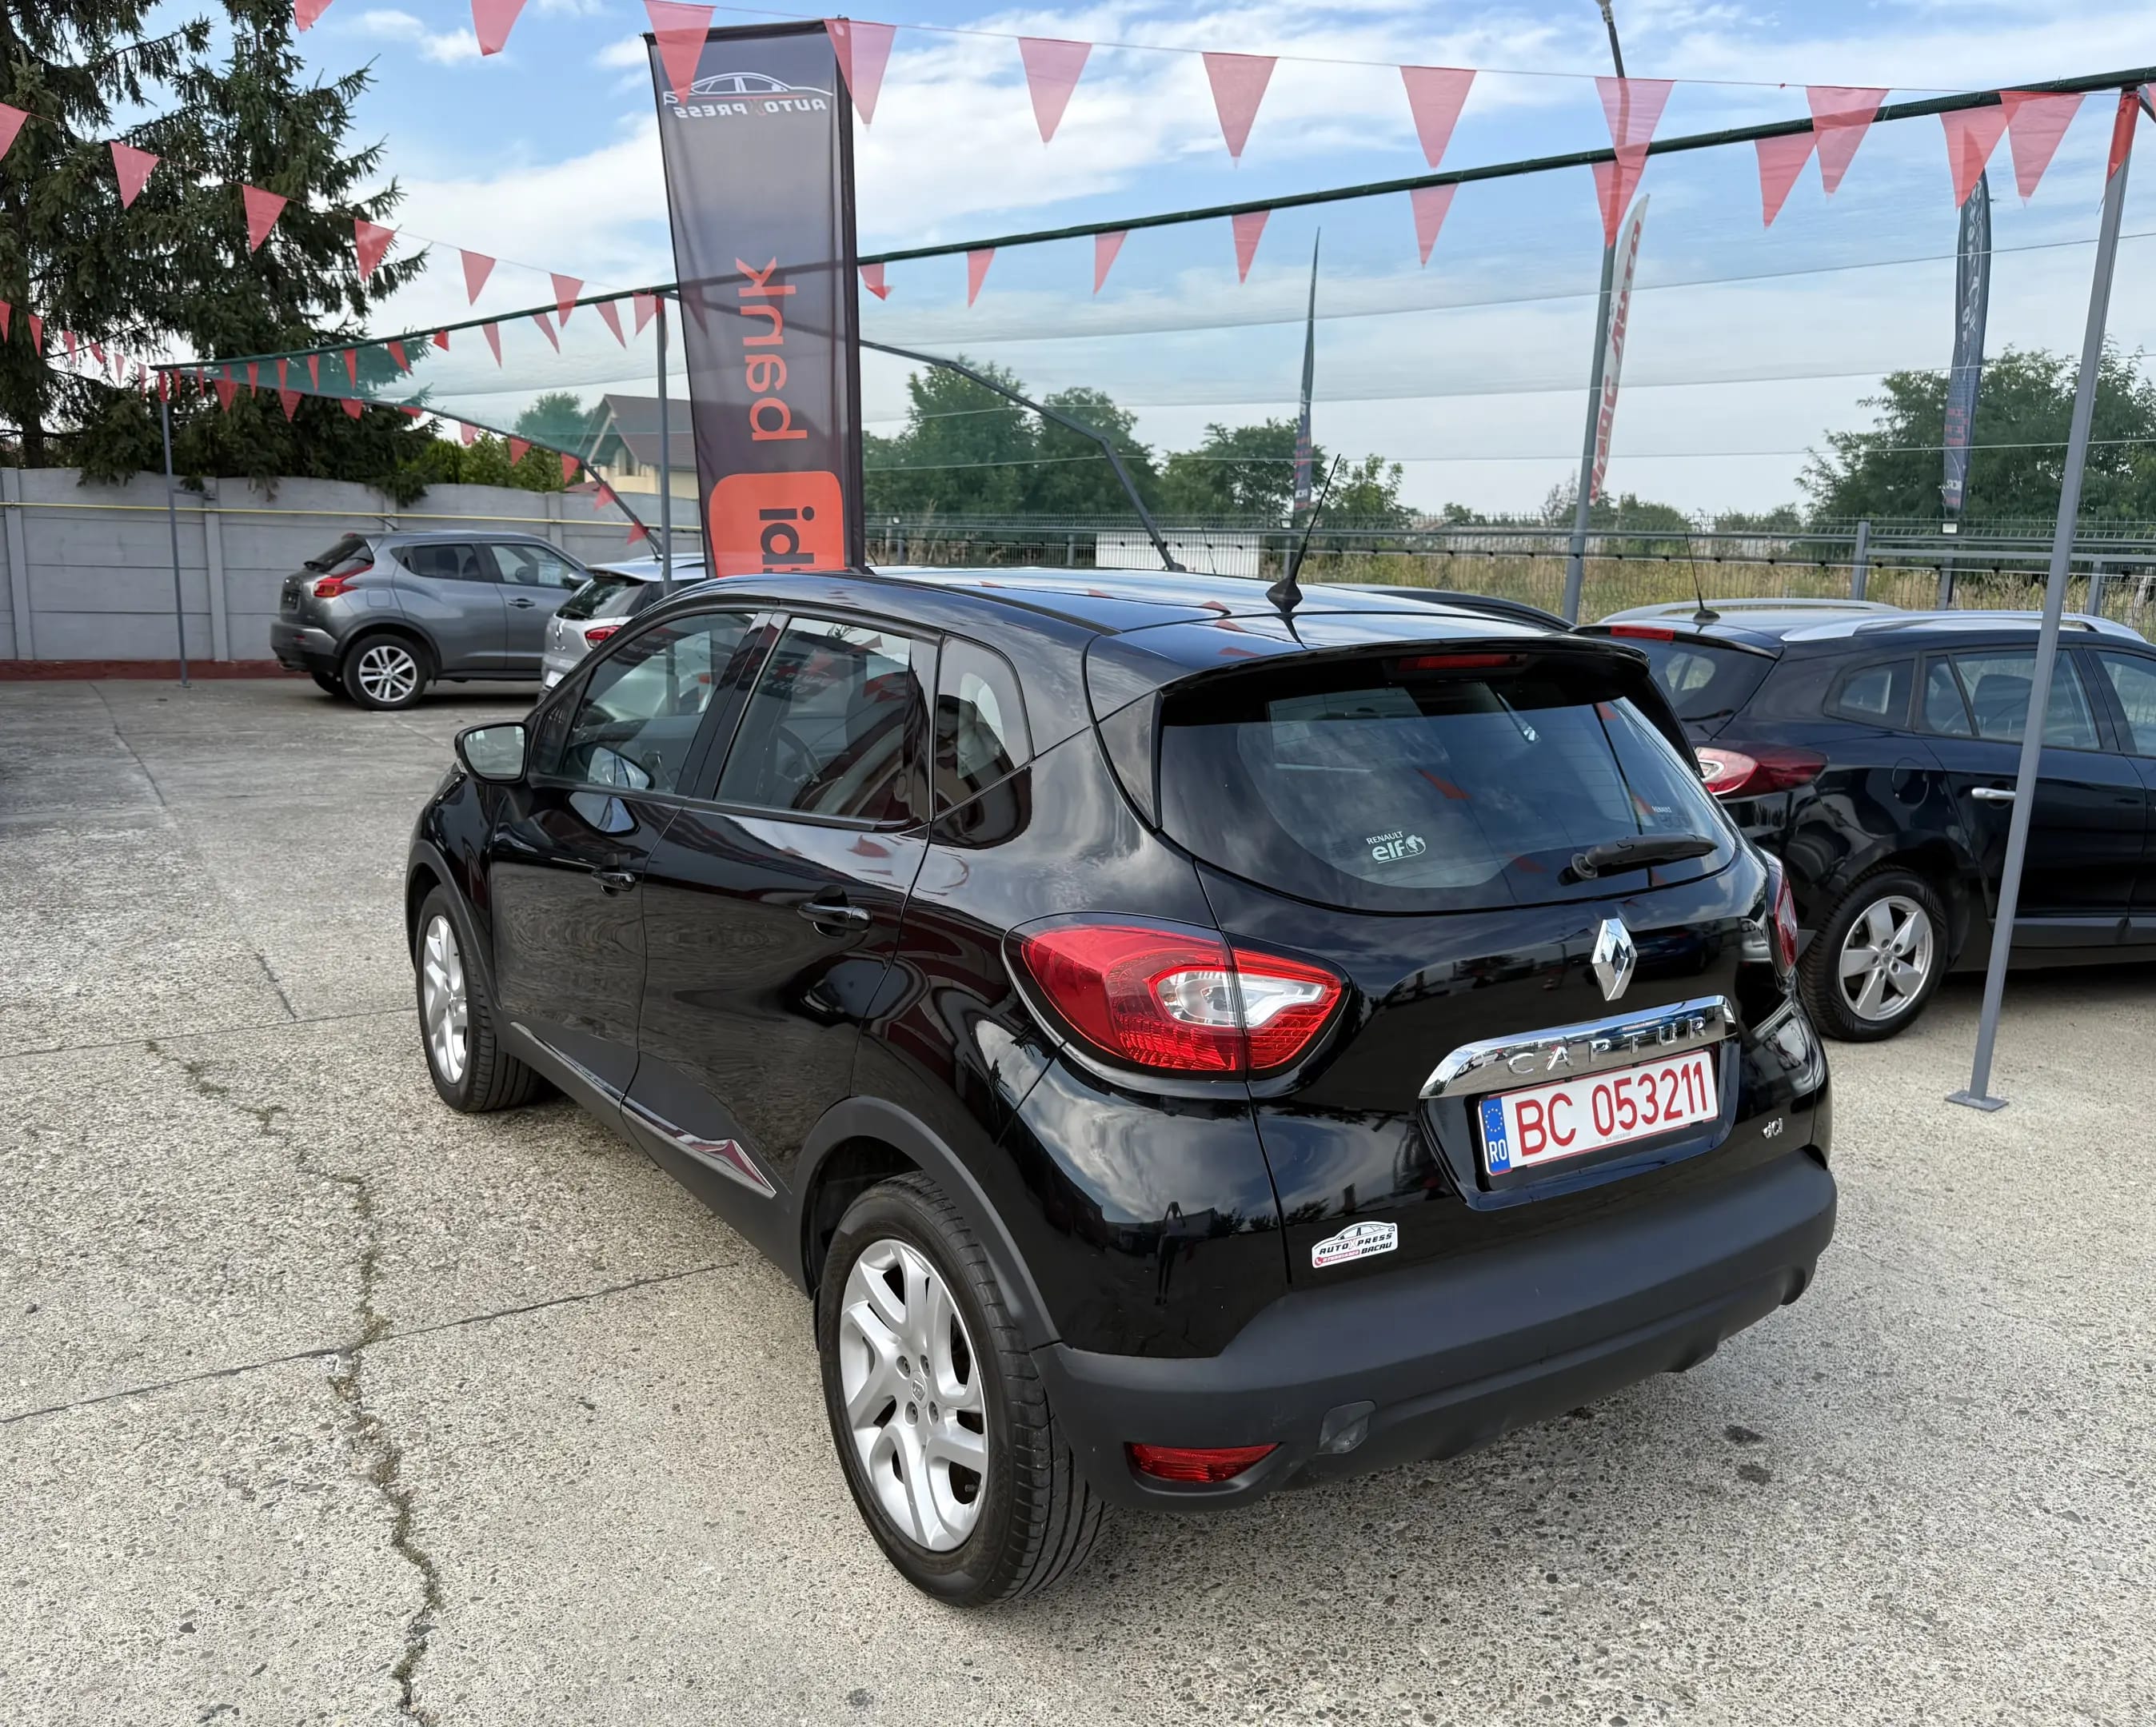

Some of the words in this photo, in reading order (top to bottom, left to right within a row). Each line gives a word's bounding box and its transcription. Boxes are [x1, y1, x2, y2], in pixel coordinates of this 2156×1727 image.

[1366, 831, 1404, 845] RENAULT
[1371, 840, 1405, 861] elf
[1507, 1015, 1707, 1076] CAPTUR
[1515, 1092, 1577, 1157] BC
[1591, 1061, 1707, 1137] 053211
[1488, 1139, 1507, 1164] RO
[1319, 1242, 1349, 1255] AUTO
[1357, 1232, 1393, 1246] PRESS
[1361, 1242, 1393, 1254] BACAU
